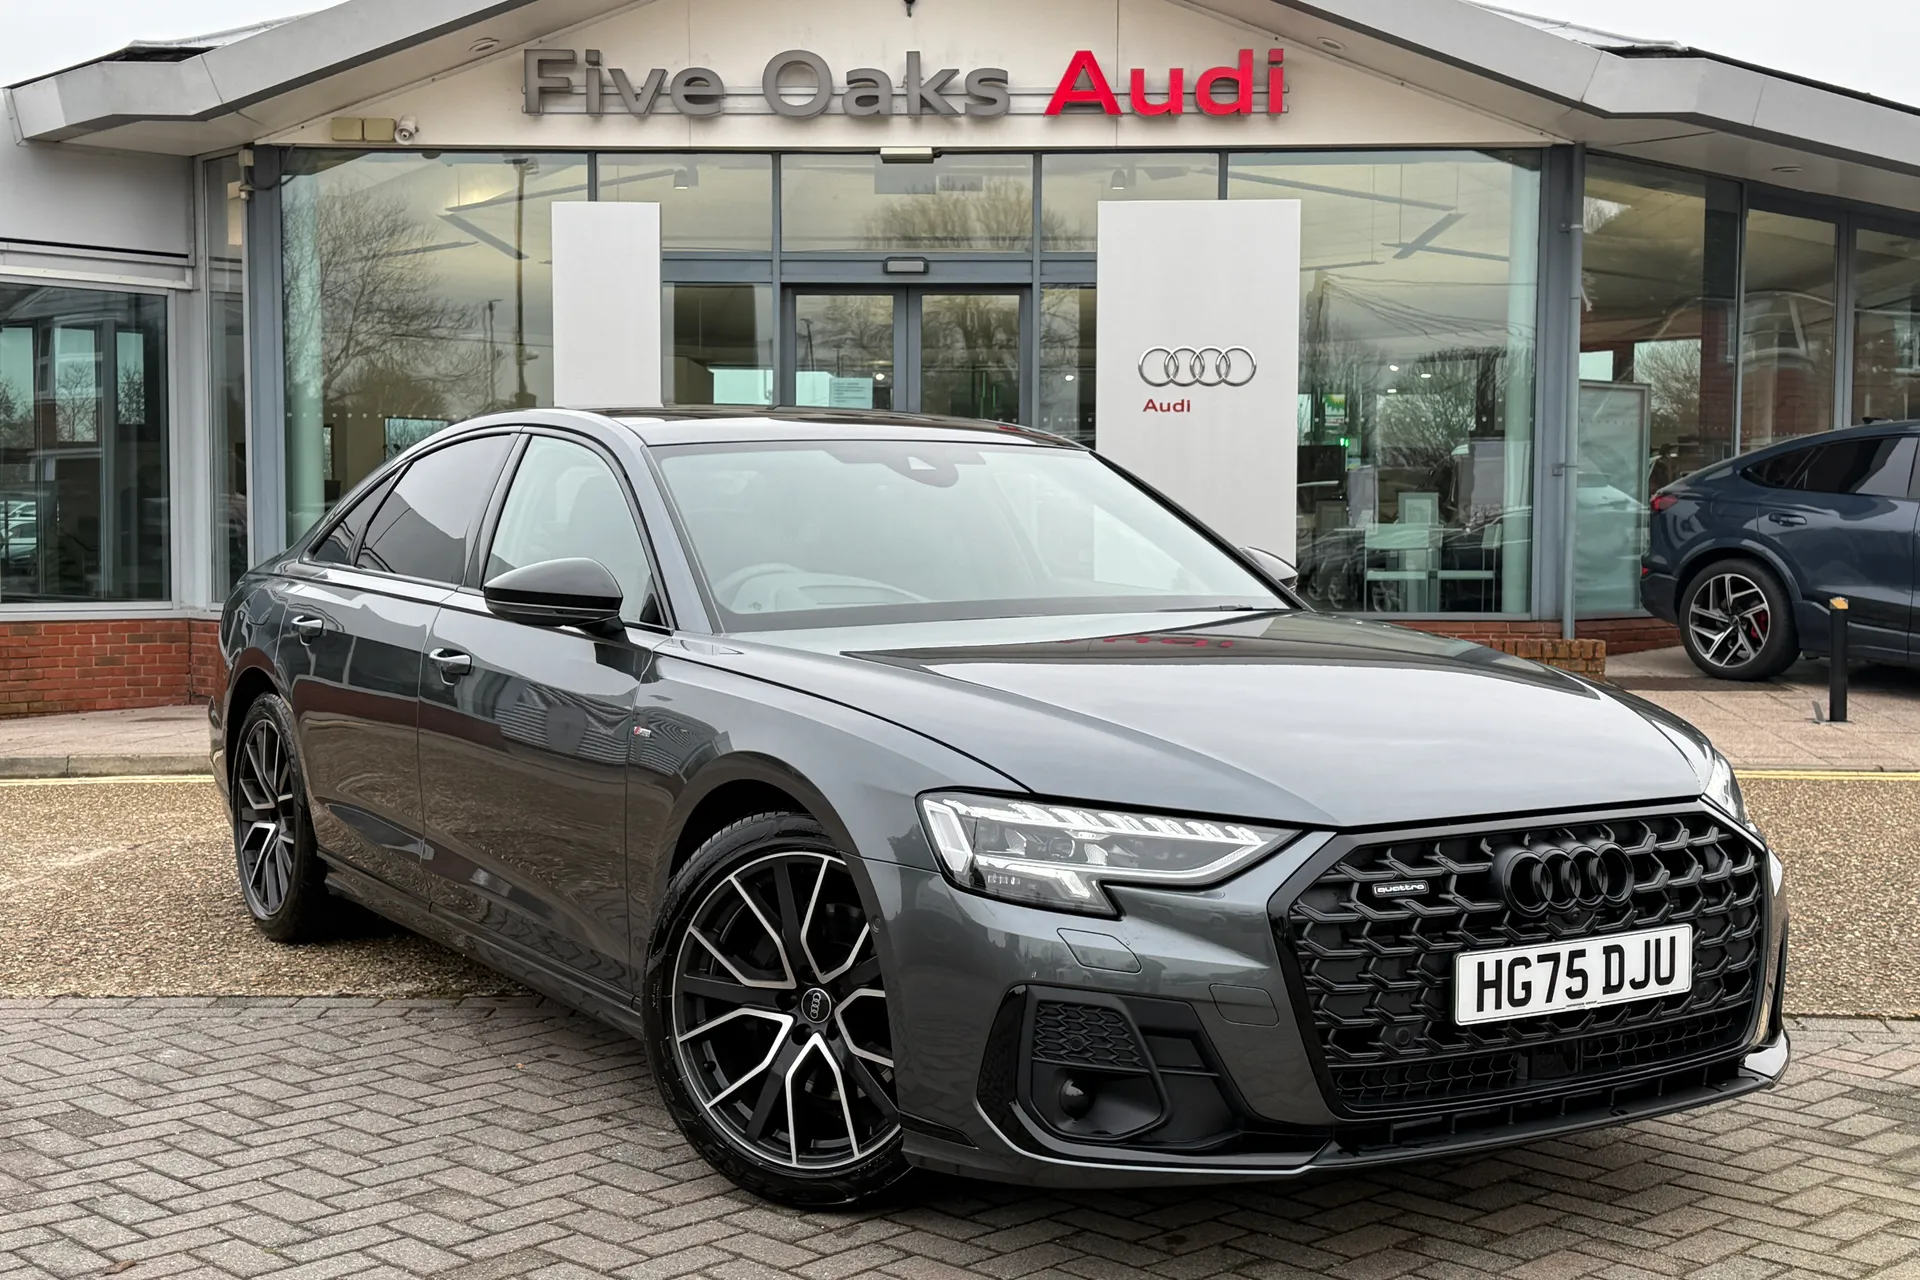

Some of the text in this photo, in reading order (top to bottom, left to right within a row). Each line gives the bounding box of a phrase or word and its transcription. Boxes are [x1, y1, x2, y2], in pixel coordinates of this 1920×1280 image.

[523, 48, 1285, 118] Five Oaks Audi
[1142, 398, 1191, 413] Audi
[1376, 884, 1425, 893] quattro
[1476, 936, 1676, 1013] HG75 DJU
